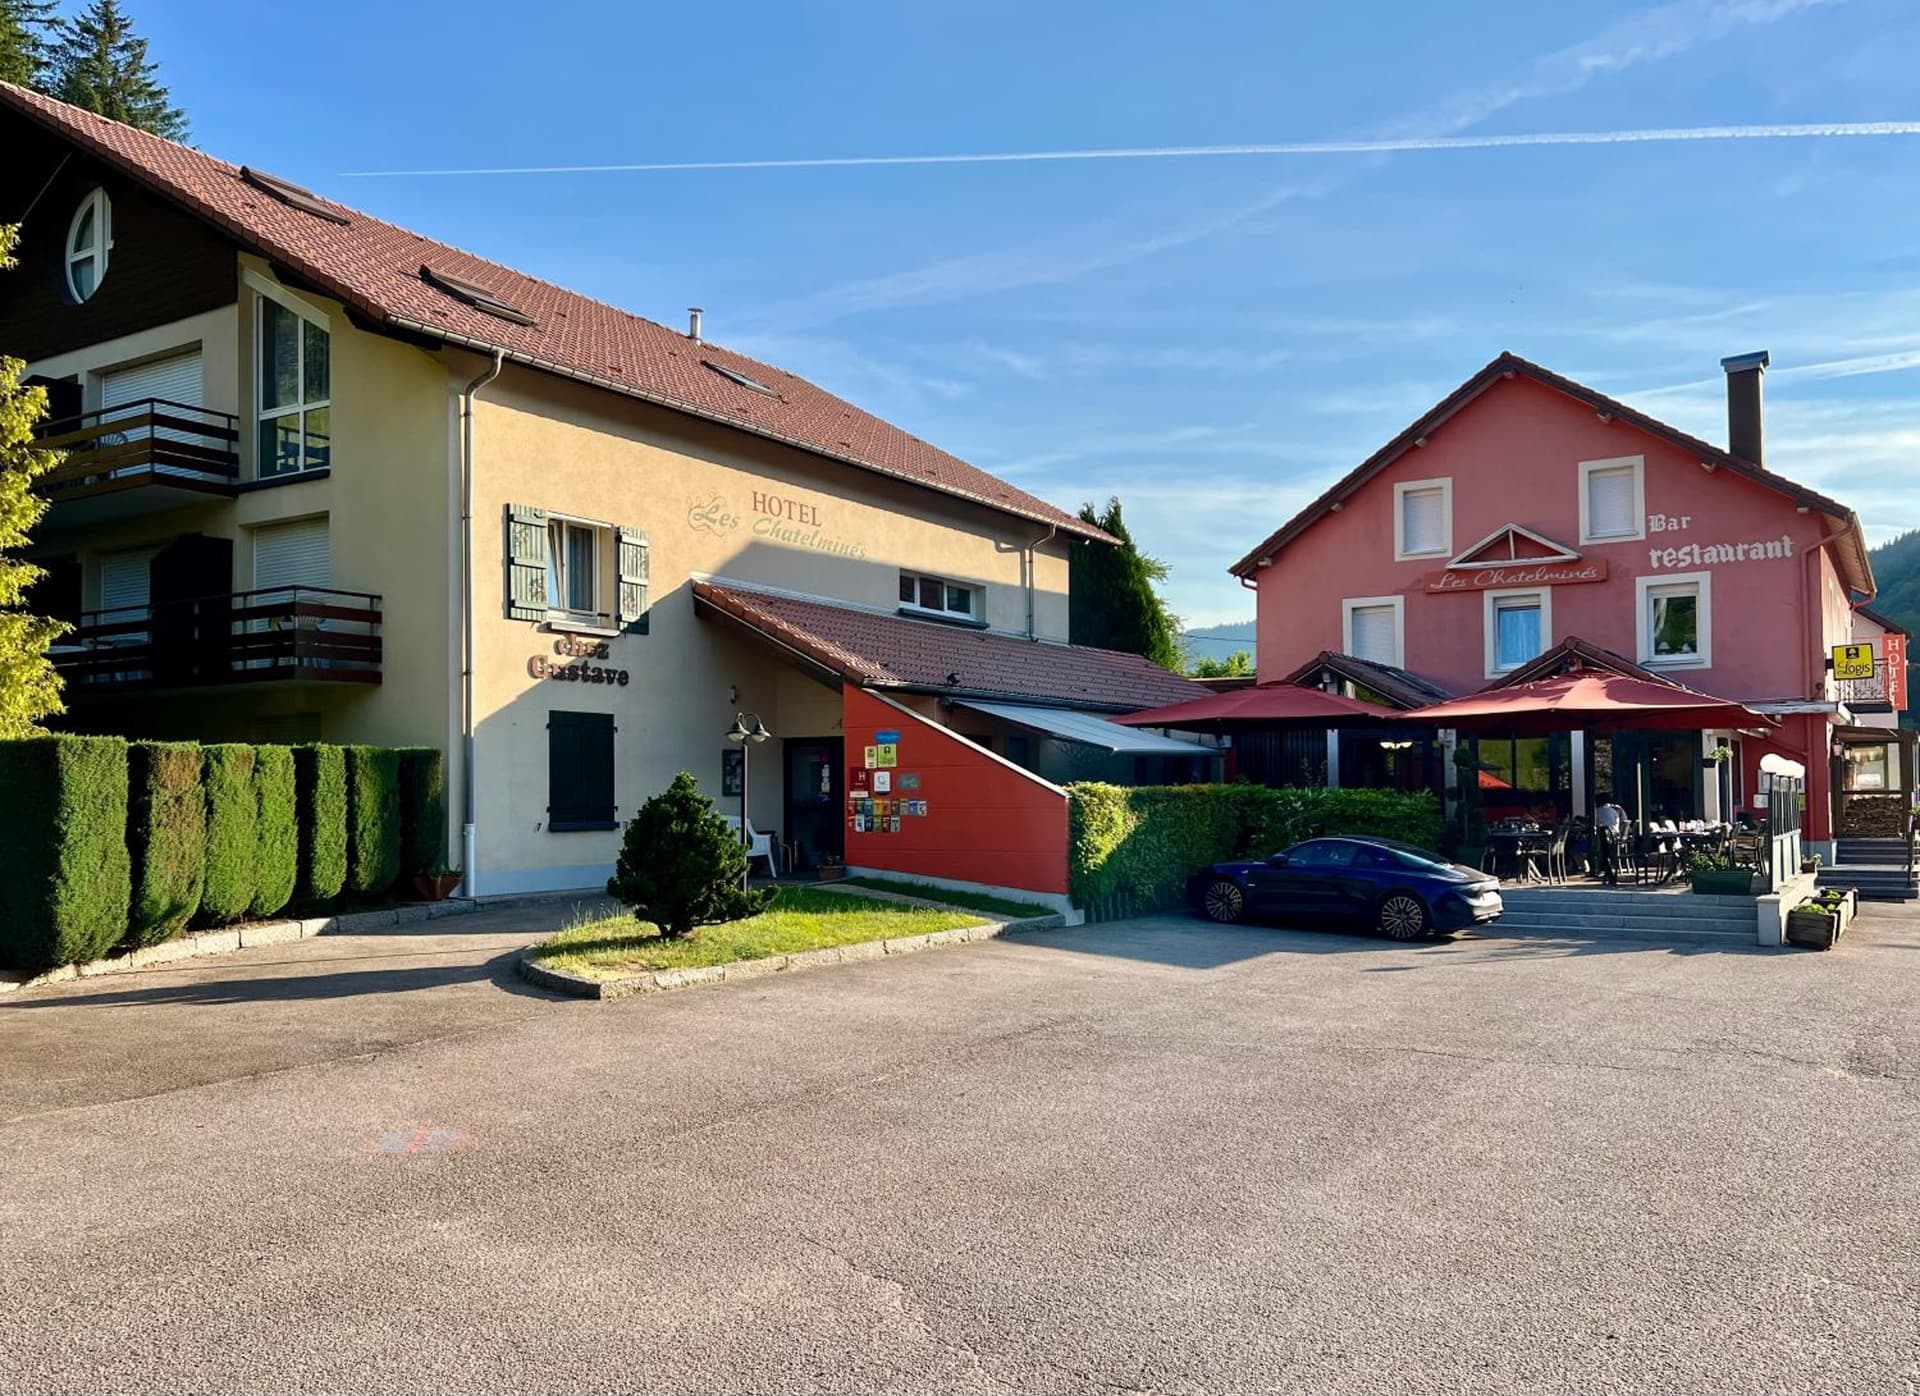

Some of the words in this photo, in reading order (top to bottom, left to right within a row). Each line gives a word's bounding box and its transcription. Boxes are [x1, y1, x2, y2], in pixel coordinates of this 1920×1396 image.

[692, 502, 740, 529] Les
[751, 490, 822, 527] HOTEL
[1648, 514, 1692, 533] Bar
[1648, 535, 1794, 569] restaurant
[1430, 572, 1467, 589] Les
[527, 654, 630, 687] Gustave
[1837, 659, 1871, 676] Logis
[1887, 639, 1901, 706] HOTEL
